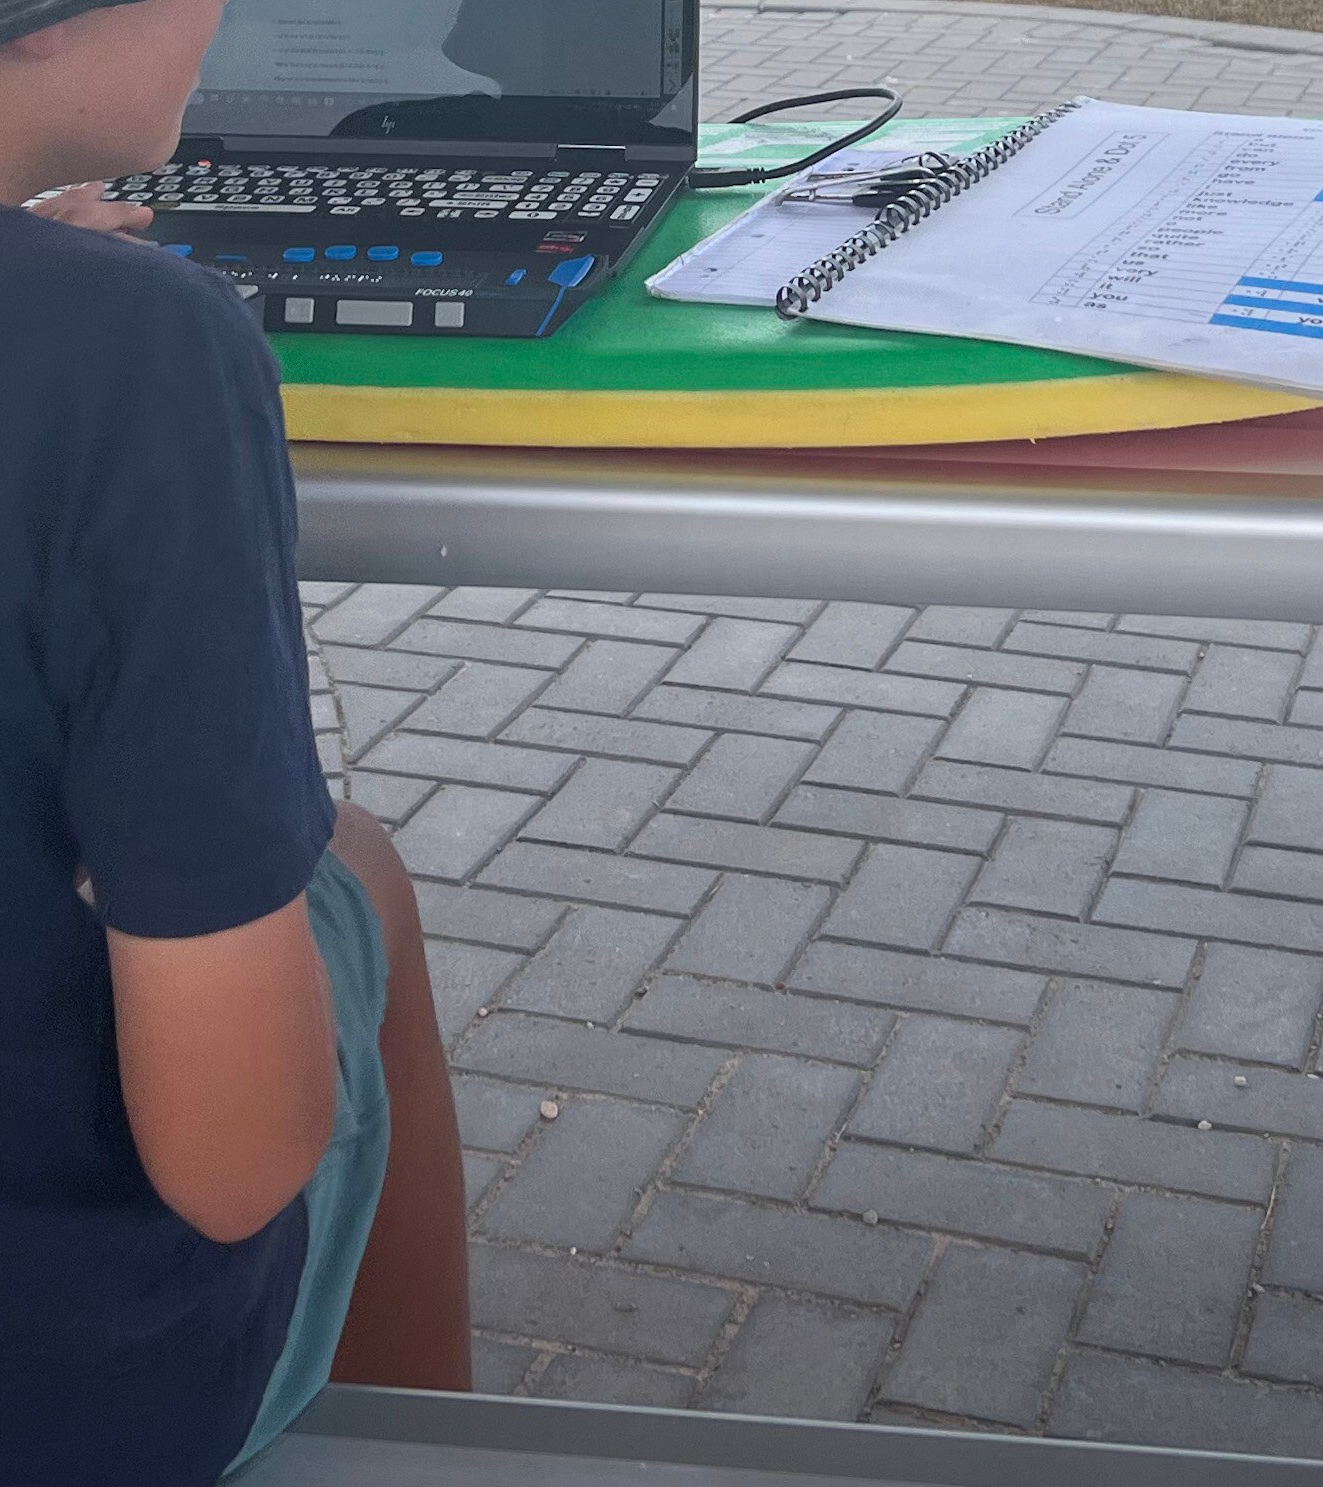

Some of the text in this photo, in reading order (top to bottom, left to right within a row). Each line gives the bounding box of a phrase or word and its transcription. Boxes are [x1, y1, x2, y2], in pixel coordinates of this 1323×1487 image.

[1230, 159, 1279, 167] every
[1130, 251, 1169, 260] that
[1116, 267, 1159, 276] very
[1108, 275, 1142, 283] will
[1090, 292, 1129, 301] you
